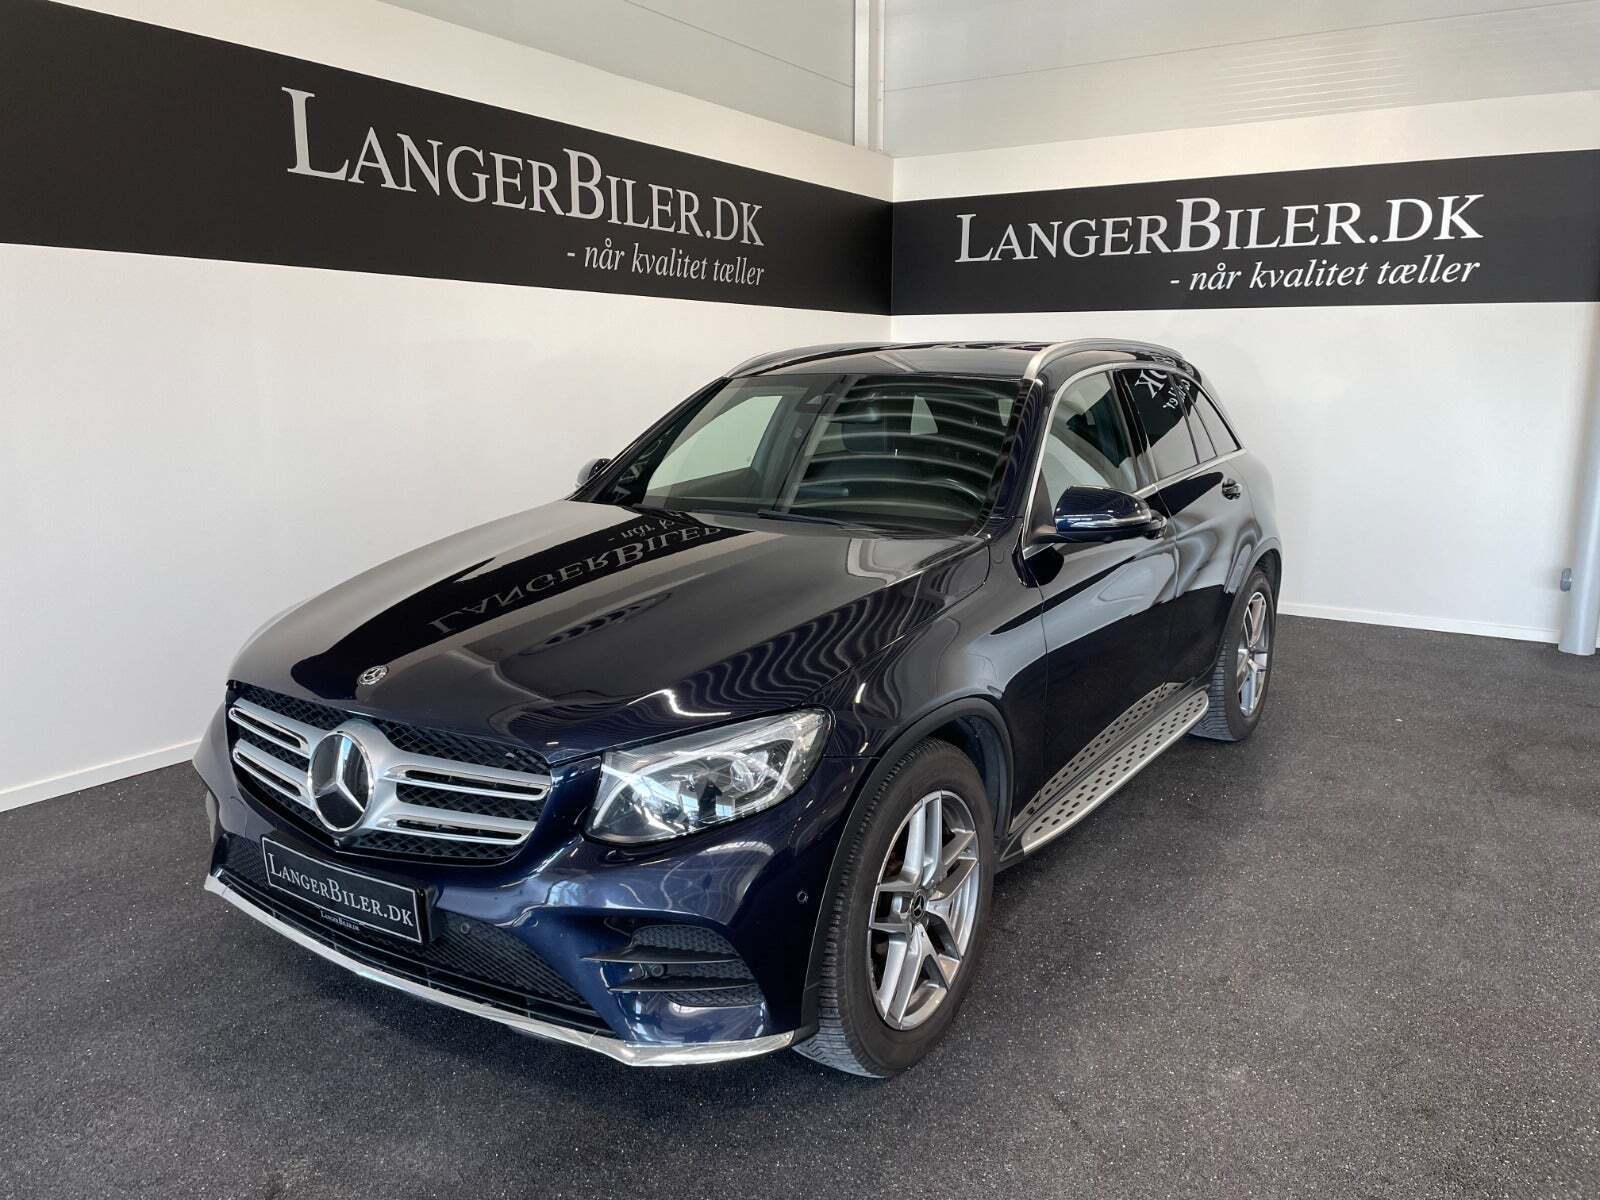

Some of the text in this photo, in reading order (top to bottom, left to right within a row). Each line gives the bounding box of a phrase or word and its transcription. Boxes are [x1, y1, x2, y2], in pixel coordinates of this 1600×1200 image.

[585, 238, 624, 271] når
[632, 243, 707, 280] kvalitet
[713, 254, 765, 286] tæller
[1189, 263, 1243, 291] når
[1249, 259, 1369, 289] kvalitet
[1377, 254, 1481, 285] tæller
